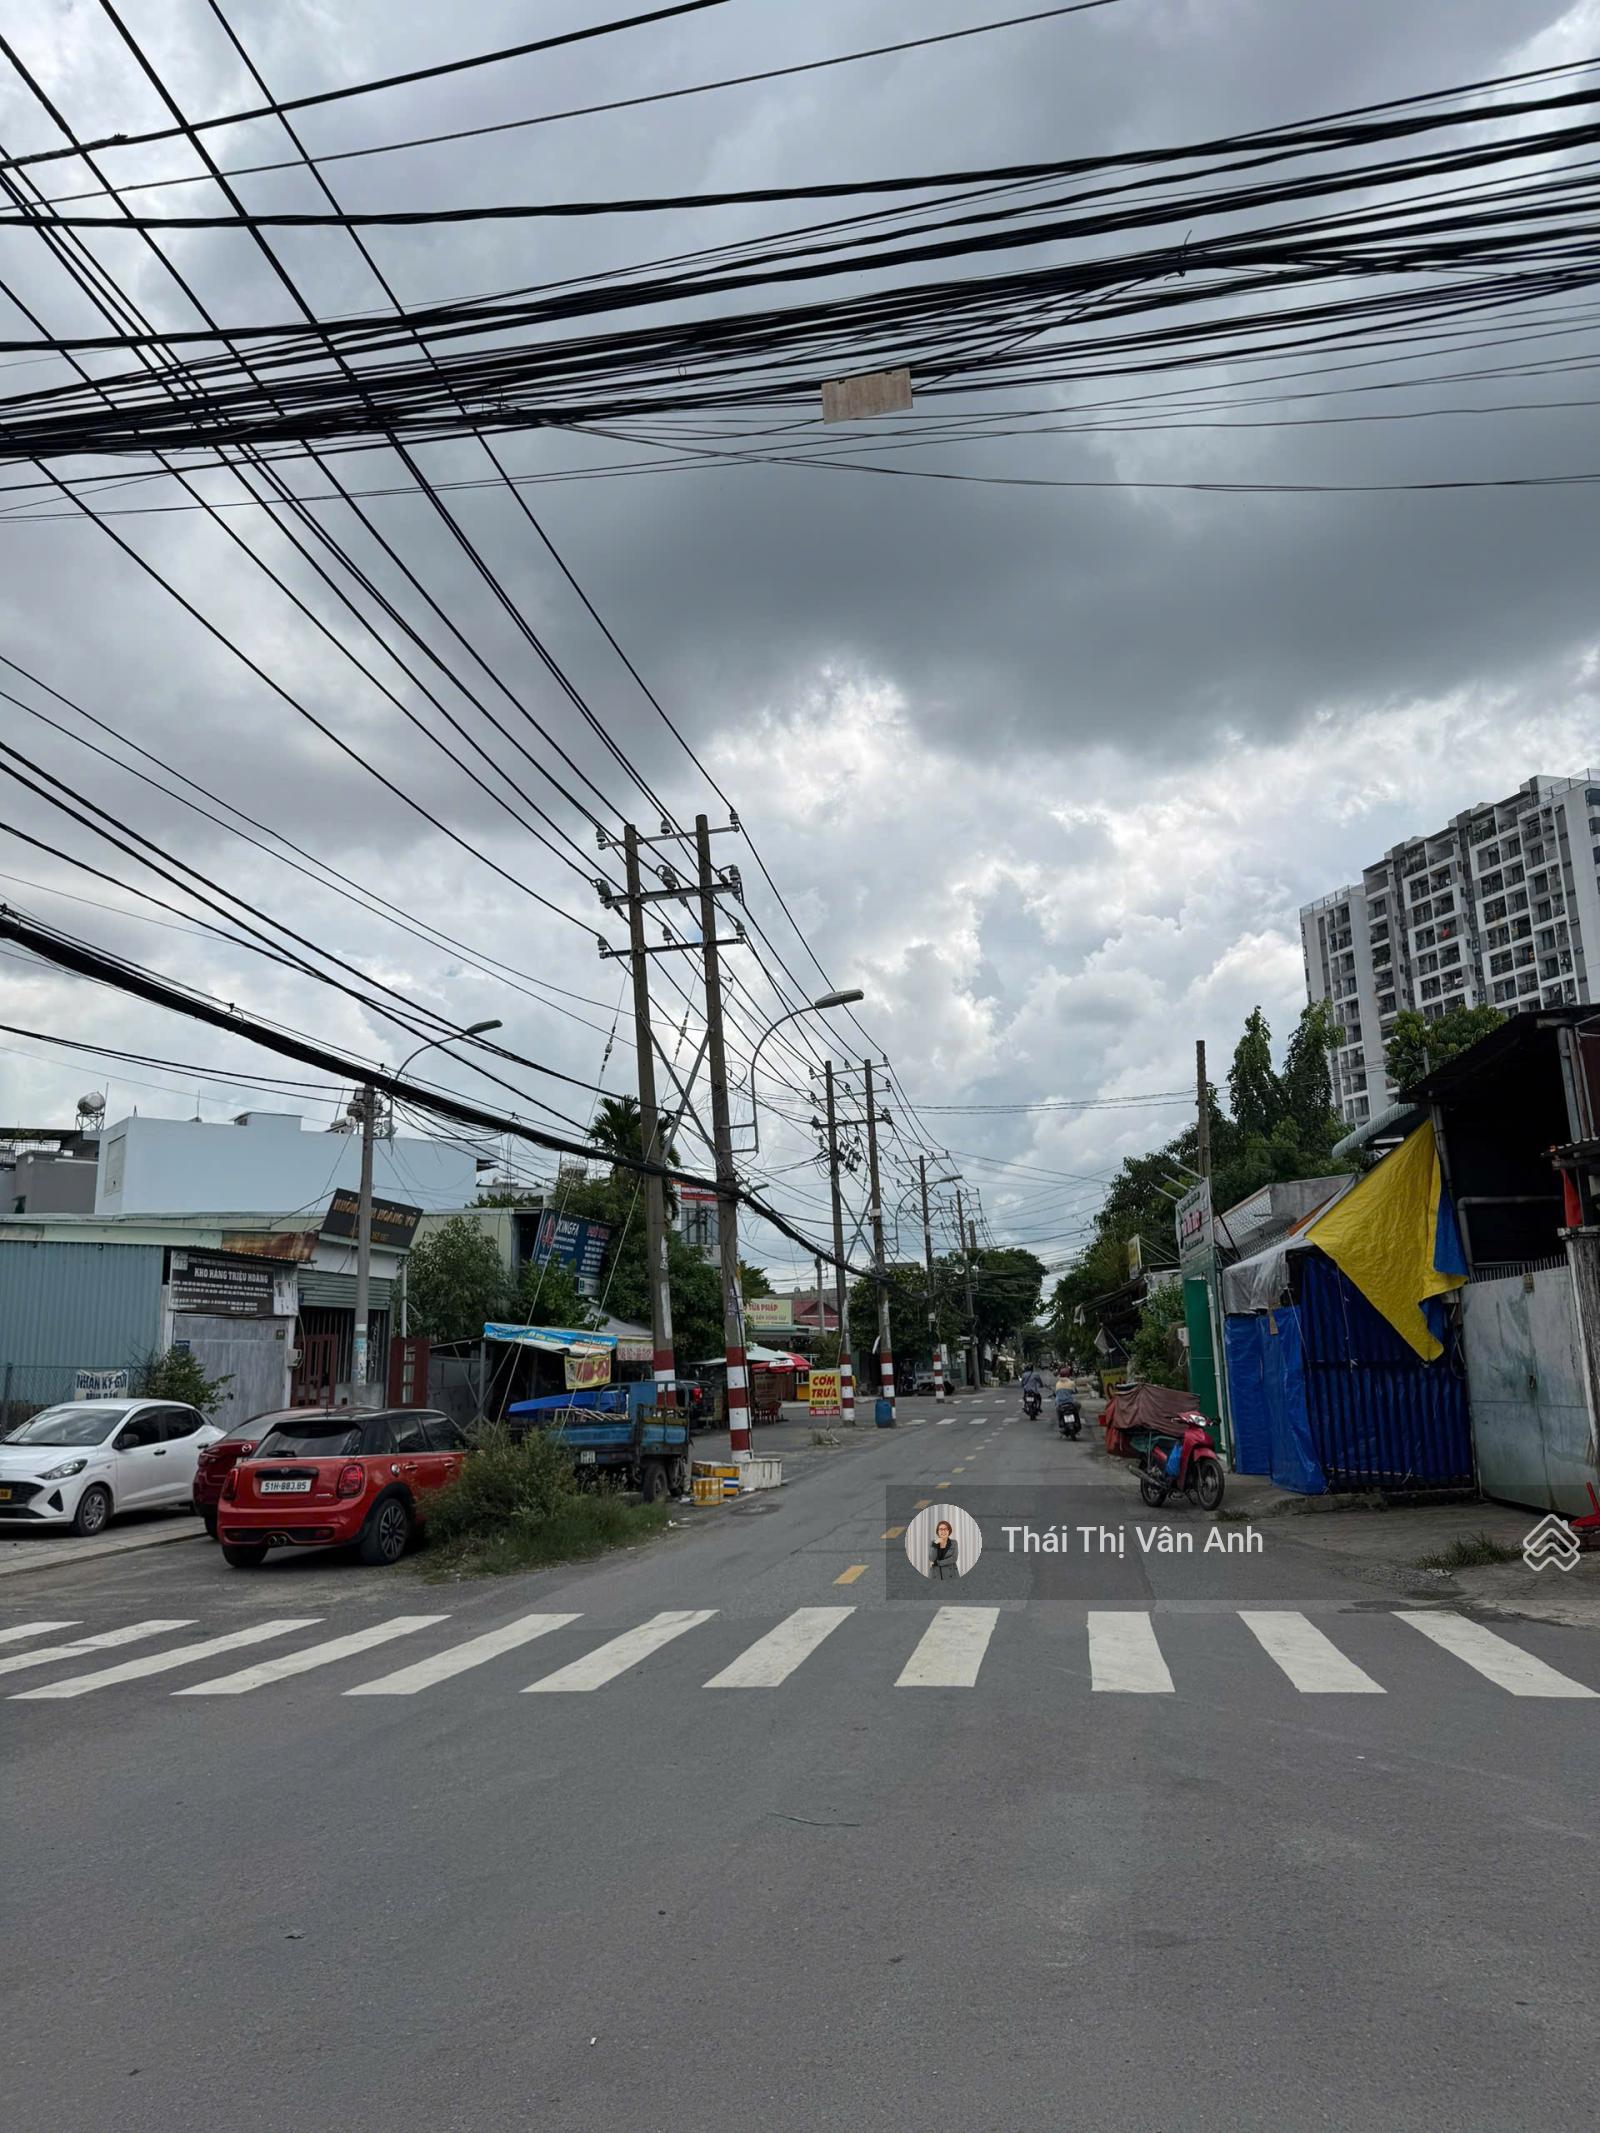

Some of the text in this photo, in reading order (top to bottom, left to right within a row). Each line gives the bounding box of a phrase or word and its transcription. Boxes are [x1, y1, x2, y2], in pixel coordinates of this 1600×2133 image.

[194, 1267, 269, 1284] KHO HÀNG TRIỆU HOÀNG
[812, 1374, 836, 1386] CƠM
[811, 1387, 837, 1398] TRƯA
